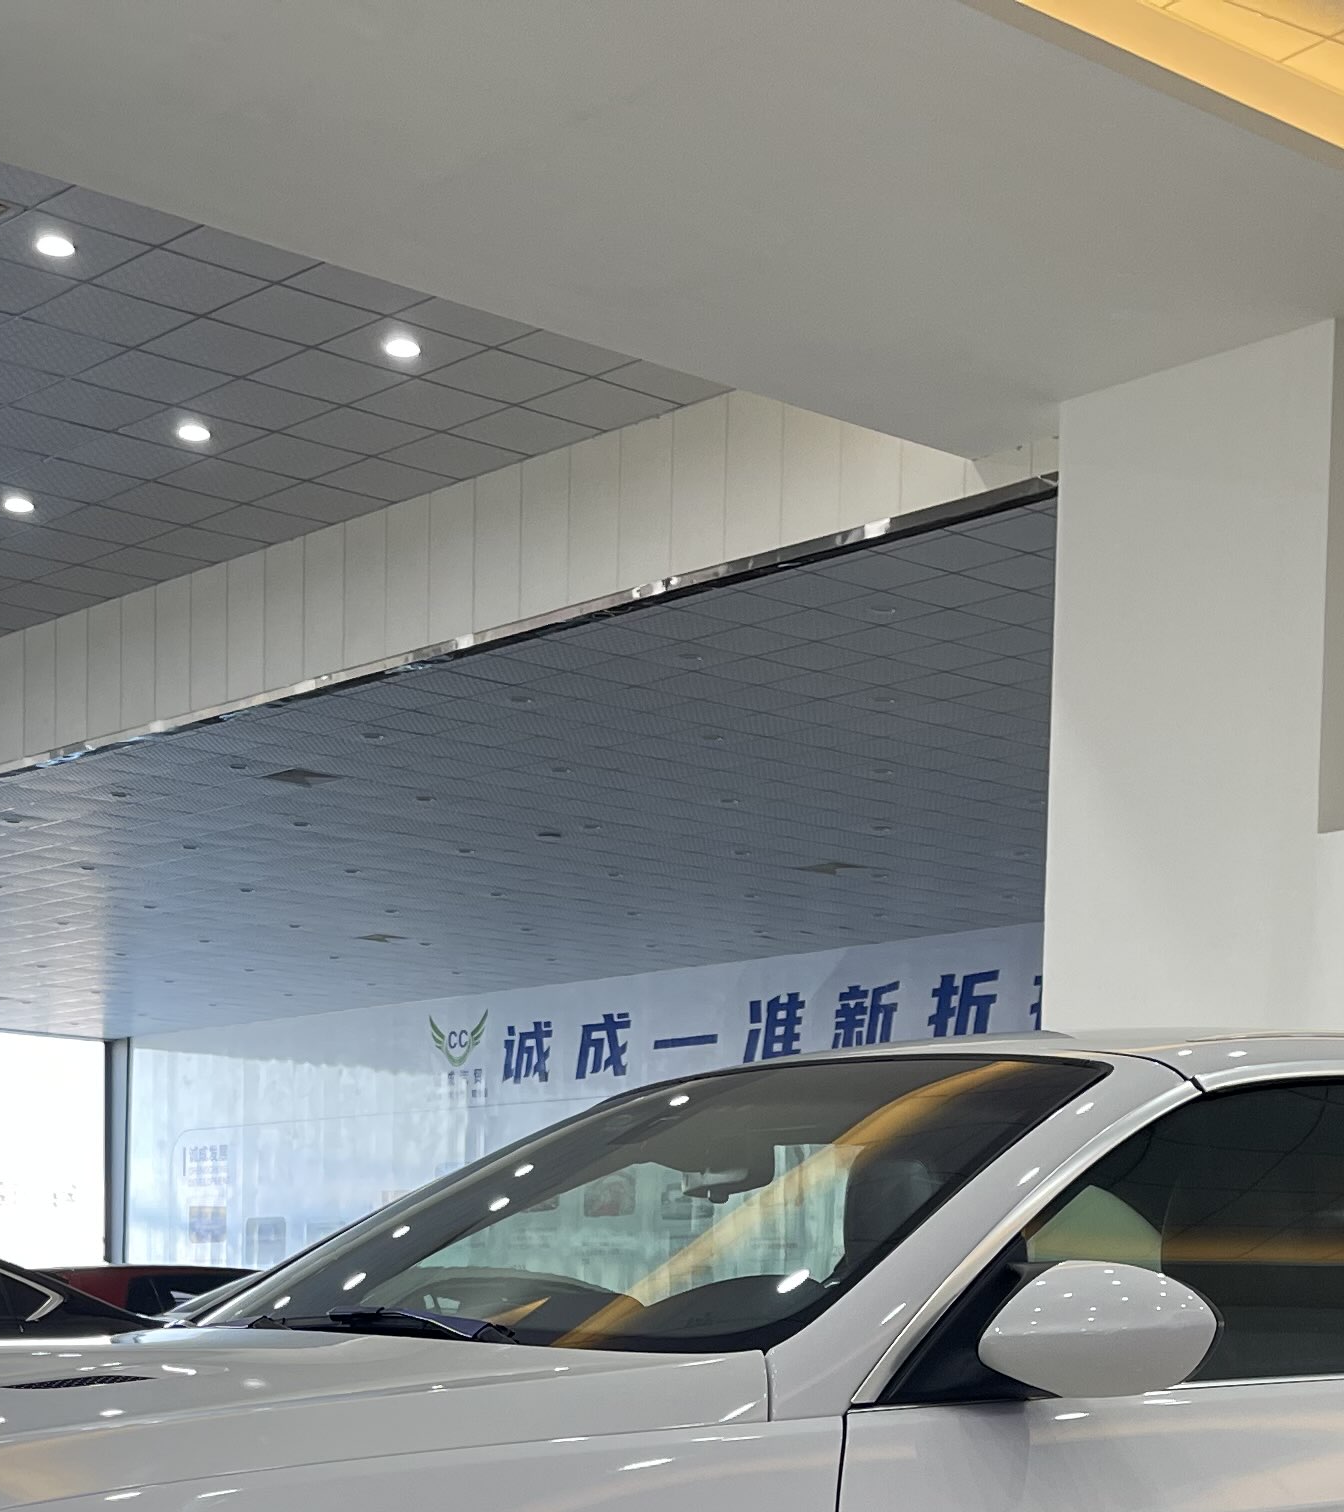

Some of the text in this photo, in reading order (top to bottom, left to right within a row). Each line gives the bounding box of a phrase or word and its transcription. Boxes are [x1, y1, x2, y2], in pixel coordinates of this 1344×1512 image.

[447, 1029, 469, 1049] CC
[502, 968, 1043, 1084] 诚成一准新折
